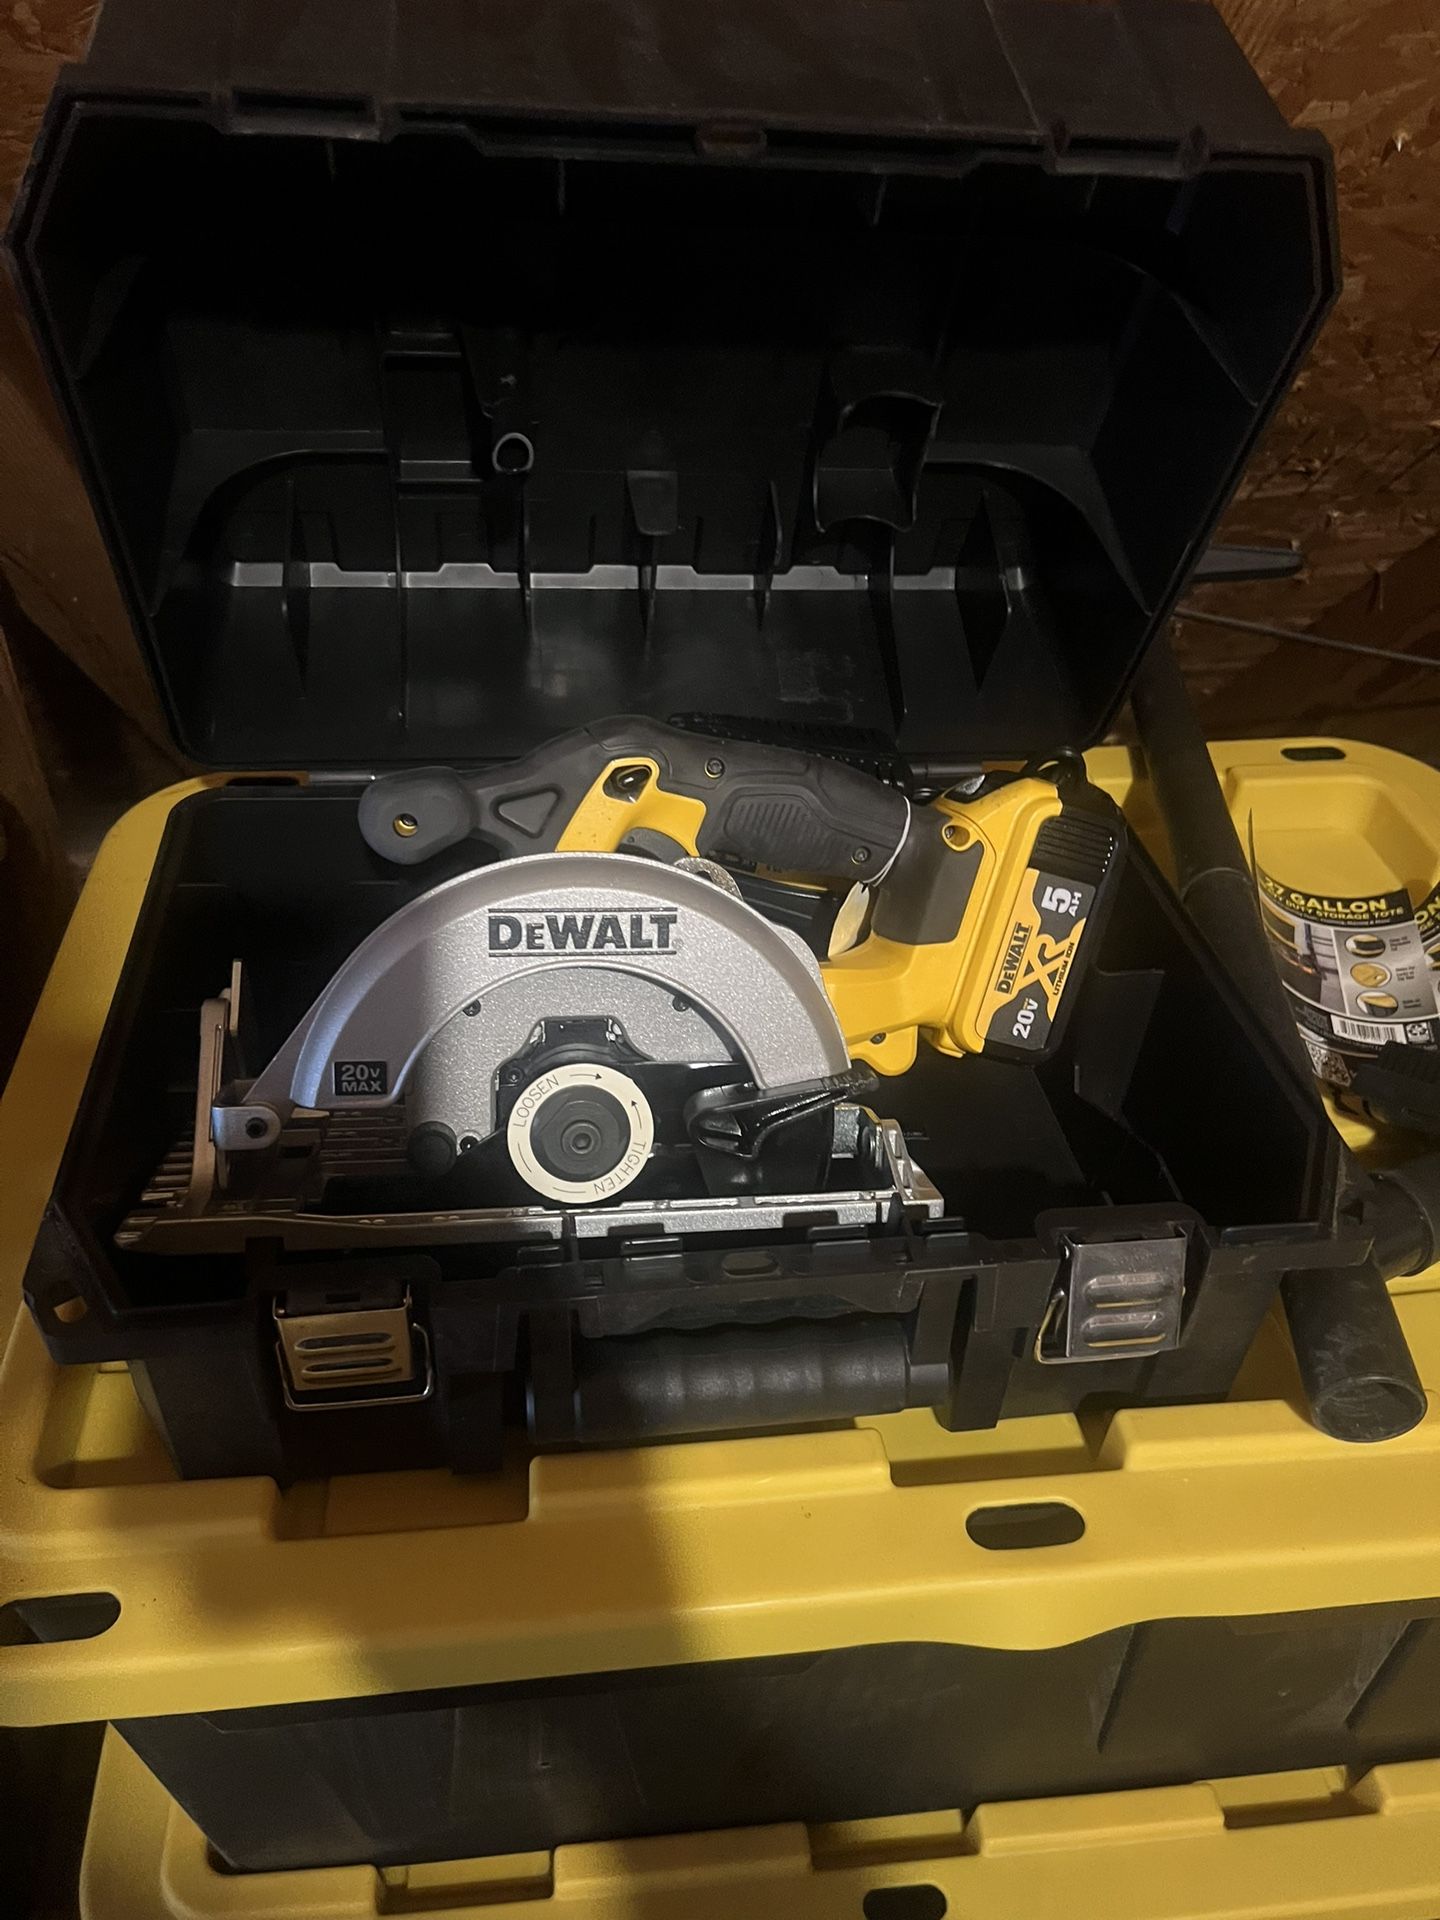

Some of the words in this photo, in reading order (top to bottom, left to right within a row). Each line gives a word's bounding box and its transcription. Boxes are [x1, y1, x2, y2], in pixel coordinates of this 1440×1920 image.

[1041, 886, 1071, 913] 5
[1290, 892, 1387, 913] GALLON
[1316, 909, 1369, 920] STORAGE
[1372, 907, 1404, 919] TOTE
[1052, 960, 1069, 996] LITHIUM
[342, 1080, 382, 1093] MAX
[512, 1074, 560, 1128] LOOSEN
[593, 1141, 648, 1196] TIGHTEN
